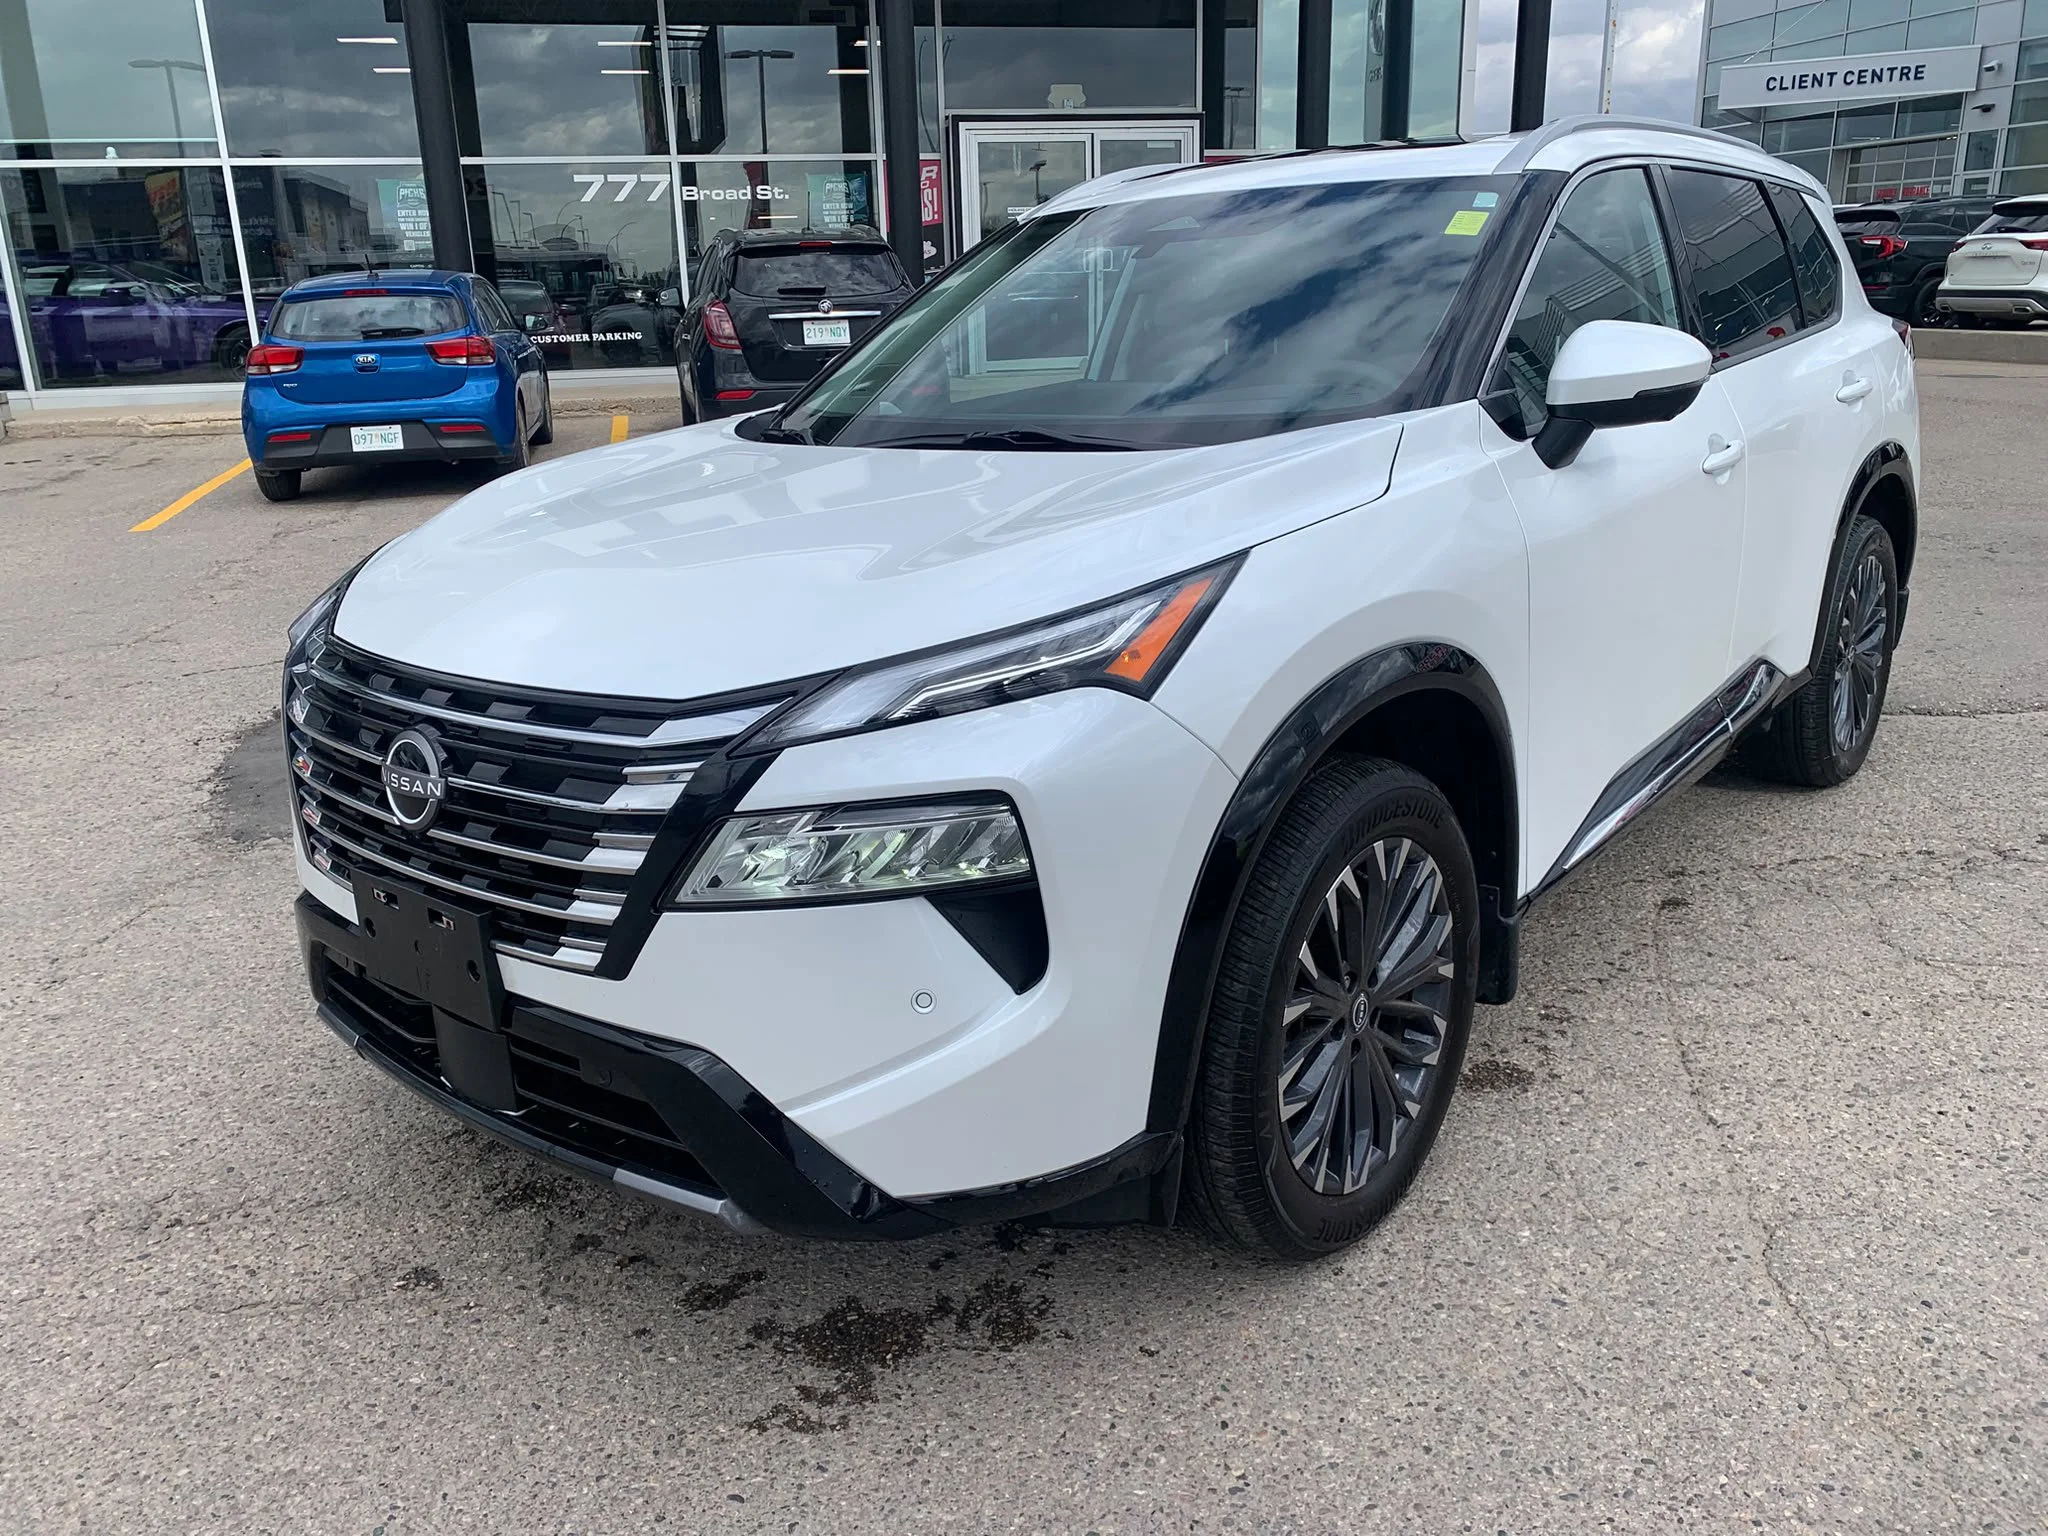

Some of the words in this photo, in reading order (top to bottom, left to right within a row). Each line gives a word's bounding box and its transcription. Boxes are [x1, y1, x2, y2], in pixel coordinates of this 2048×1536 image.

[1766, 72, 1838, 92] CLIENT
[1843, 64, 1926, 86] CENTRE
[573, 174, 671, 202] 777
[682, 186, 751, 200] Broad
[756, 185, 790, 200] St.
[530, 334, 590, 344] CUSTOMER
[592, 332, 643, 341] PARKING
[806, 327, 824, 338] 219
[353, 432, 373, 446] 097
[380, 431, 400, 445] NGF
[381, 764, 441, 797] NISSAN
